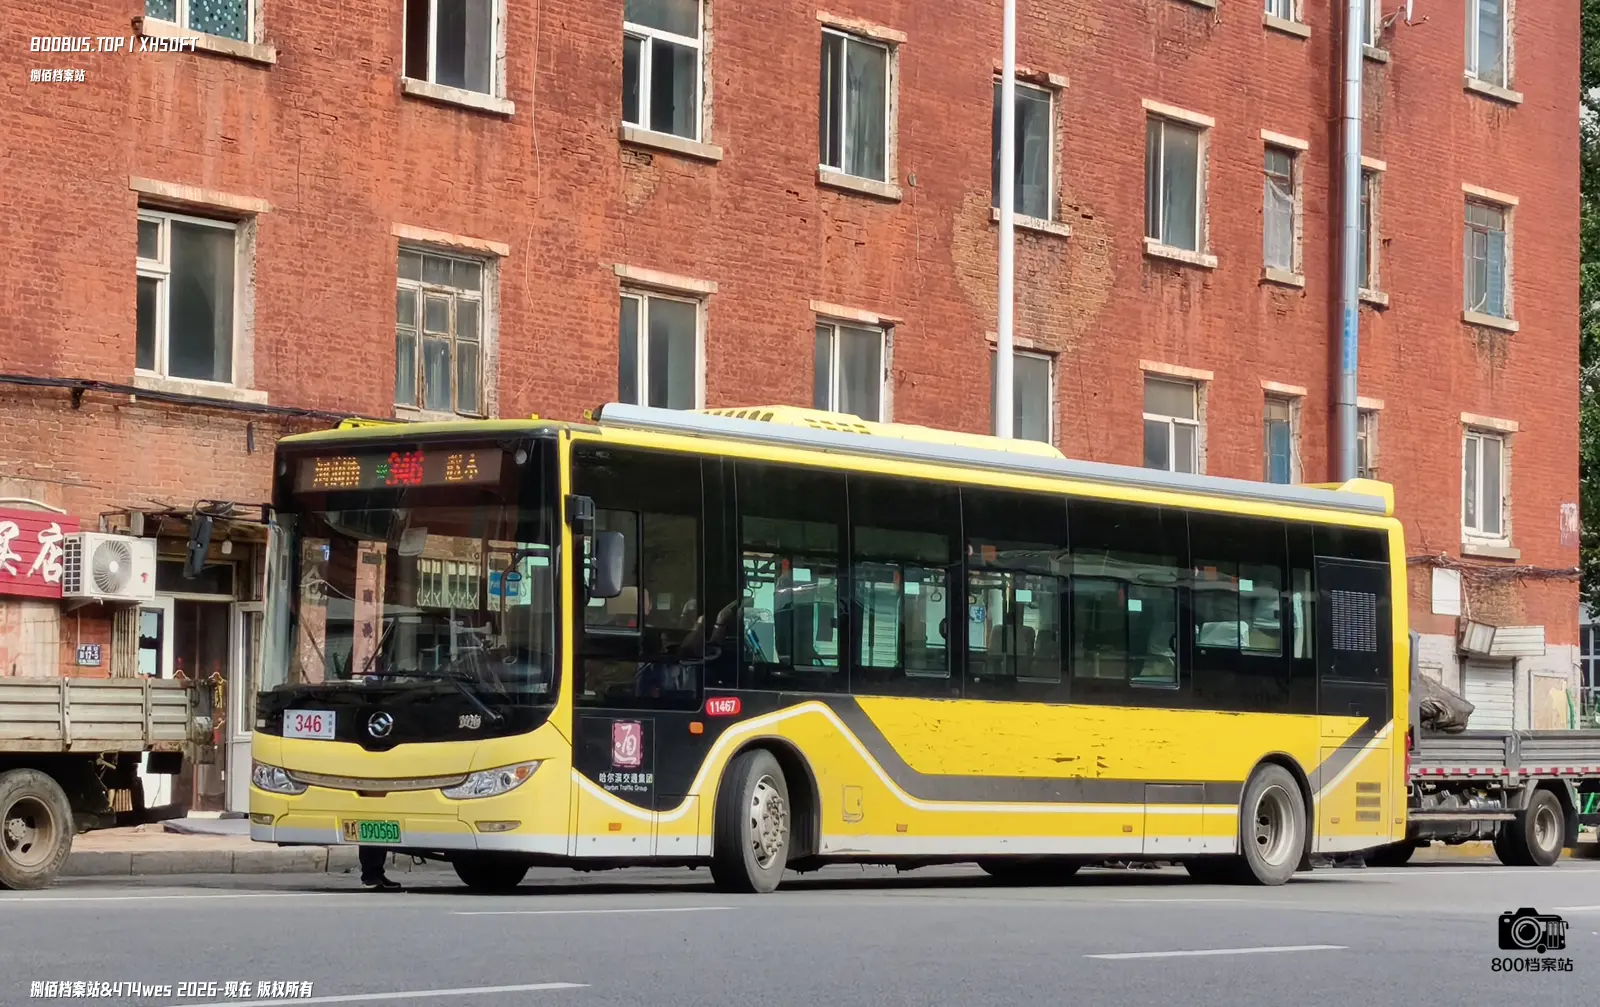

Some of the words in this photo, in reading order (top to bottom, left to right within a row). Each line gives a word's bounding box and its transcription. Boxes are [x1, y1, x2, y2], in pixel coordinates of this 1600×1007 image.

[710, 700, 736, 713] 11467
[295, 714, 322, 733] 346
[599, 772, 653, 784] 哈尔滨交通集团
